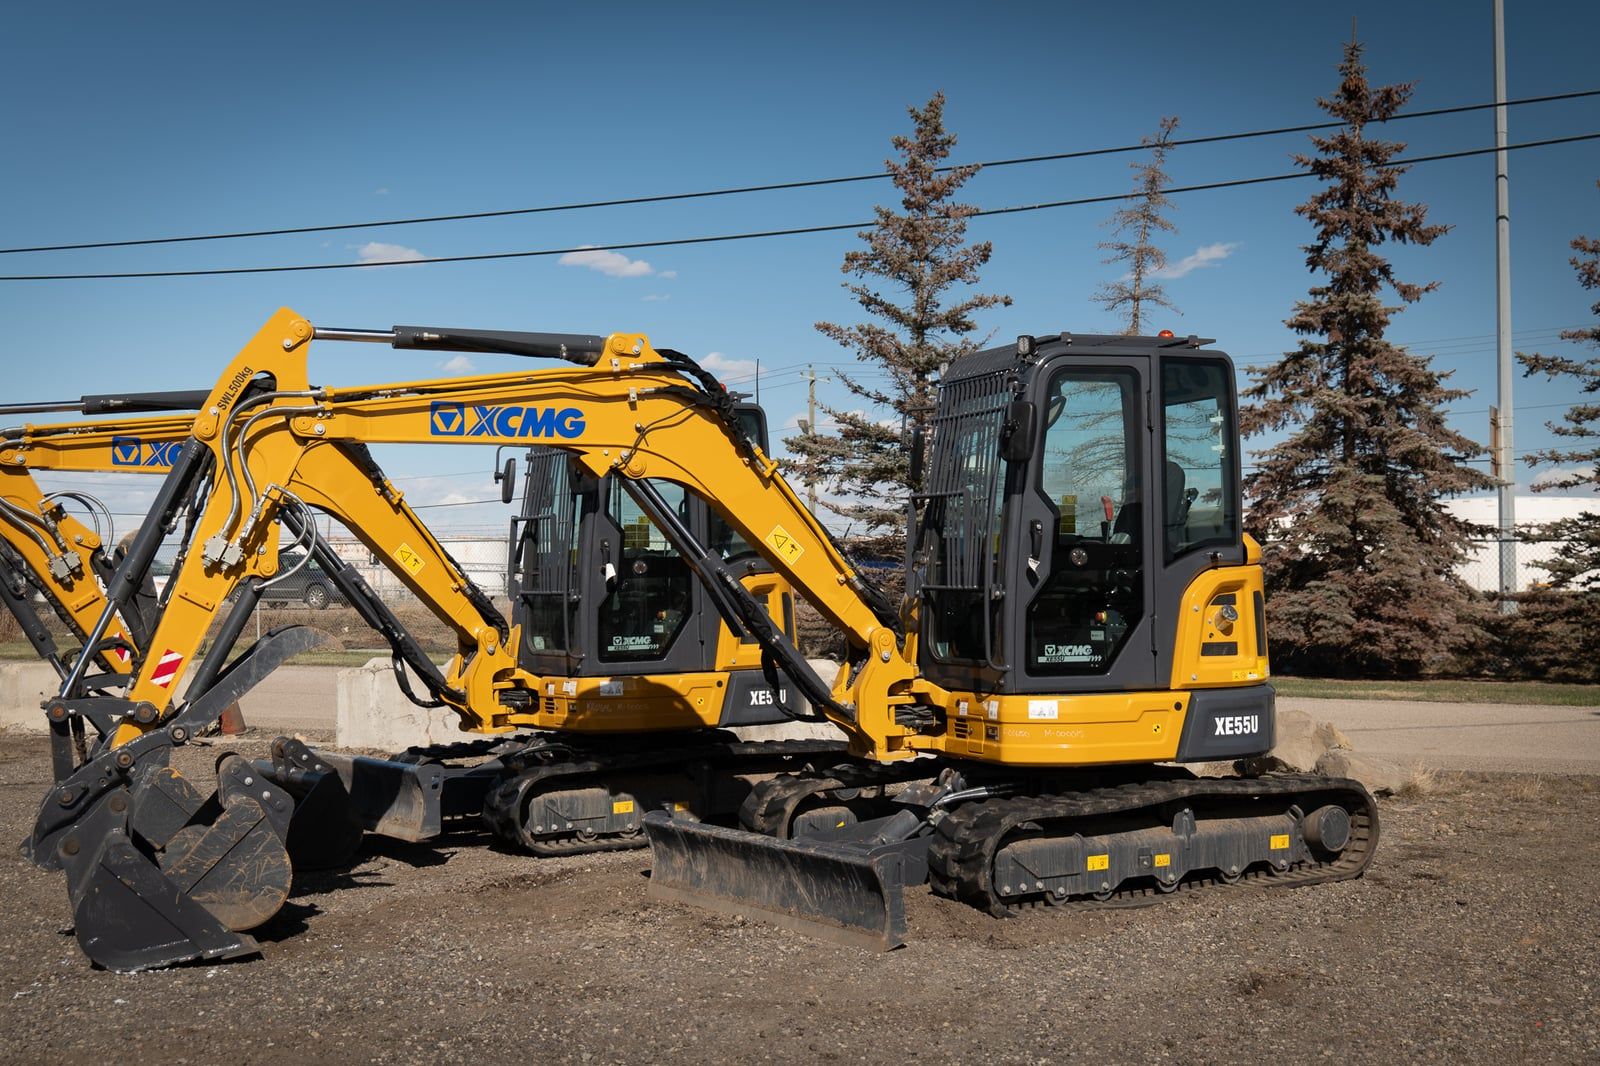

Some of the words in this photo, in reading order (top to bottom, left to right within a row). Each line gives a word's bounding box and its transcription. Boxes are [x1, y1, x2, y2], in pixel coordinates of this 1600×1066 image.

[217, 366, 254, 410] SWL500kg
[465, 406, 586, 439] XCMG
[622, 636, 652, 646] XCMG
[1056, 645, 1093, 656] XCMG
[750, 689, 787, 706] XE5U
[1214, 714, 1259, 736] XE55U
